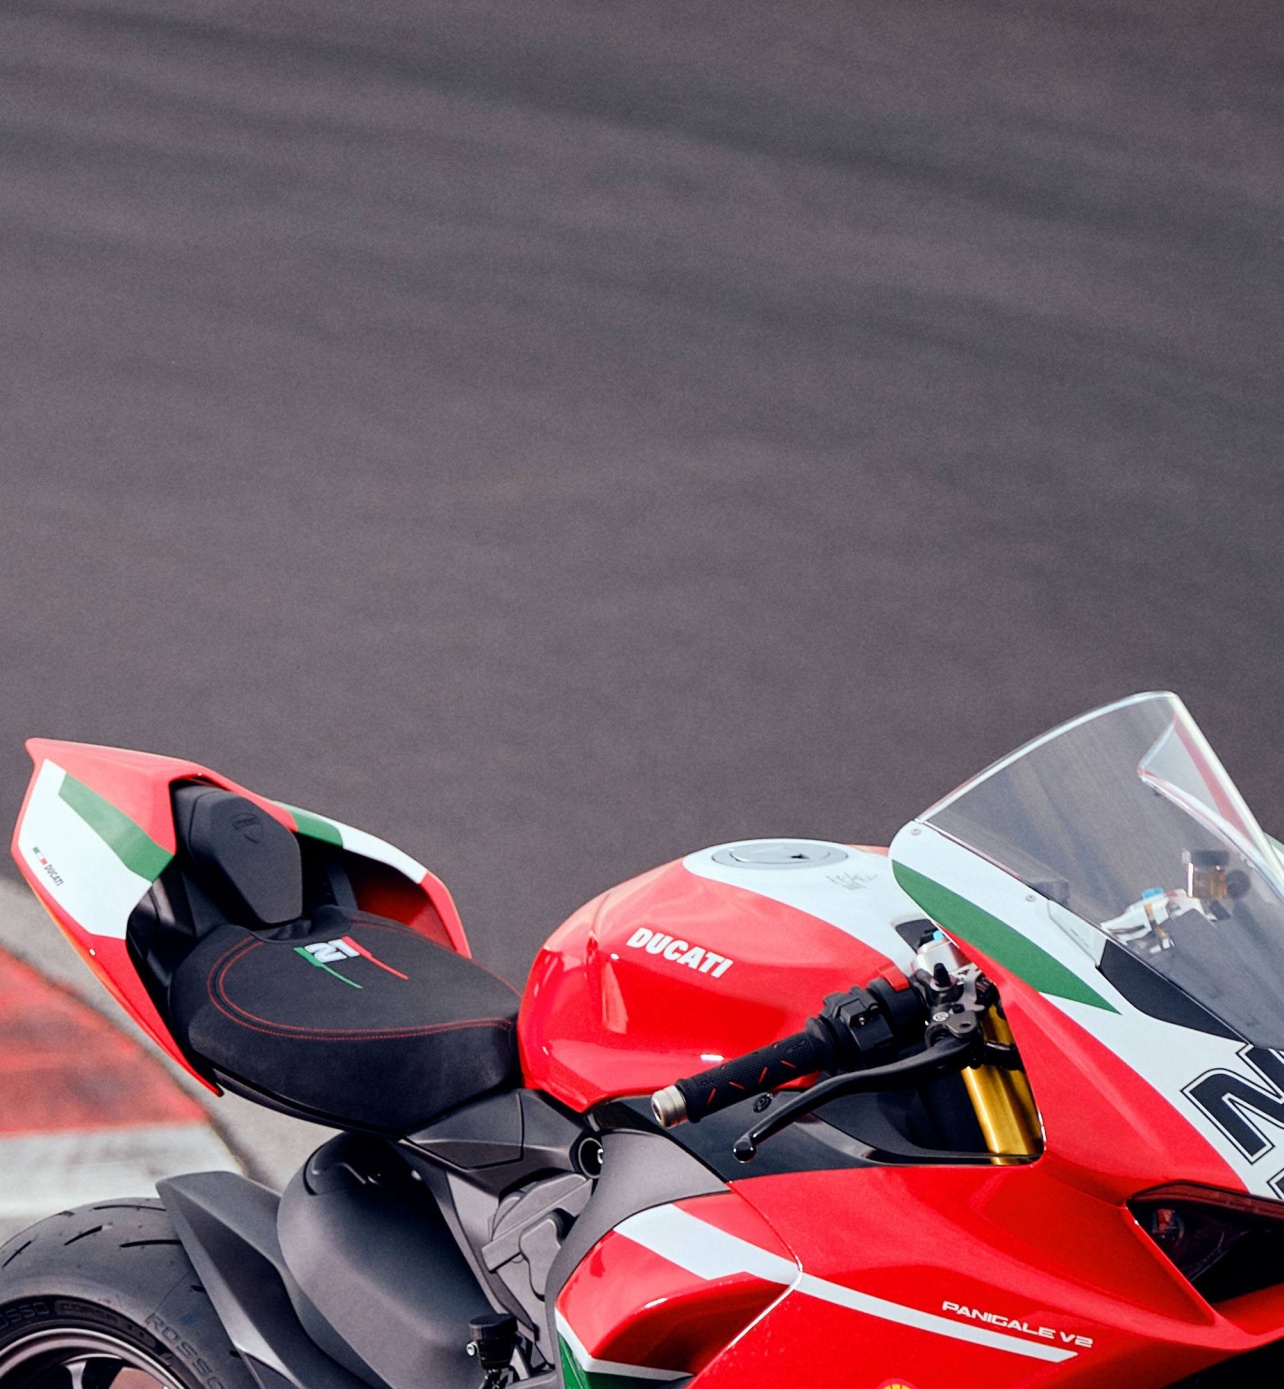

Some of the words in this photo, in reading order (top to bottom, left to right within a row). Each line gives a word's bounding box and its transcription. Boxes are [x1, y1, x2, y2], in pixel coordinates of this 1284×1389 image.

[44, 864, 64, 887] DUCATI
[626, 927, 734, 979] DUCATI
[942, 1301, 1056, 1339] PANIGALE
[1059, 1331, 1094, 1348] V2
